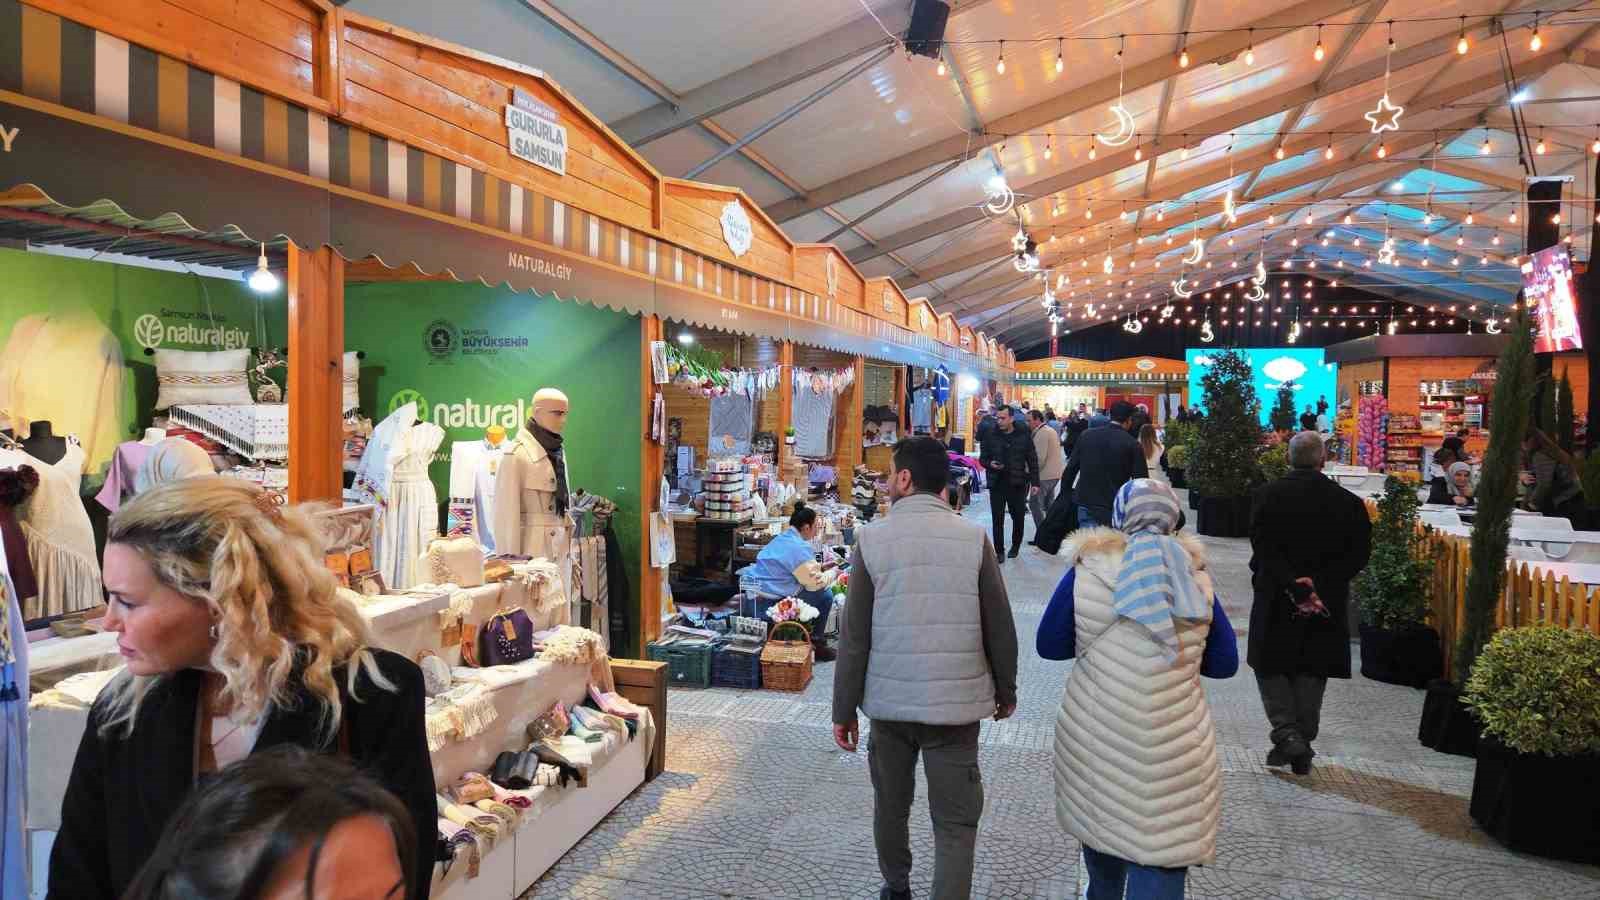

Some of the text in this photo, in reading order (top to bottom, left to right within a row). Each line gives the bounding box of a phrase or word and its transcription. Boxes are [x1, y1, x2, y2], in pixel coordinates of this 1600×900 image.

[511, 108, 564, 145] GURURLA
[515, 136, 563, 170] SAMSUN
[166, 322, 250, 351] naturalgiy
[433, 397, 534, 429] natural
